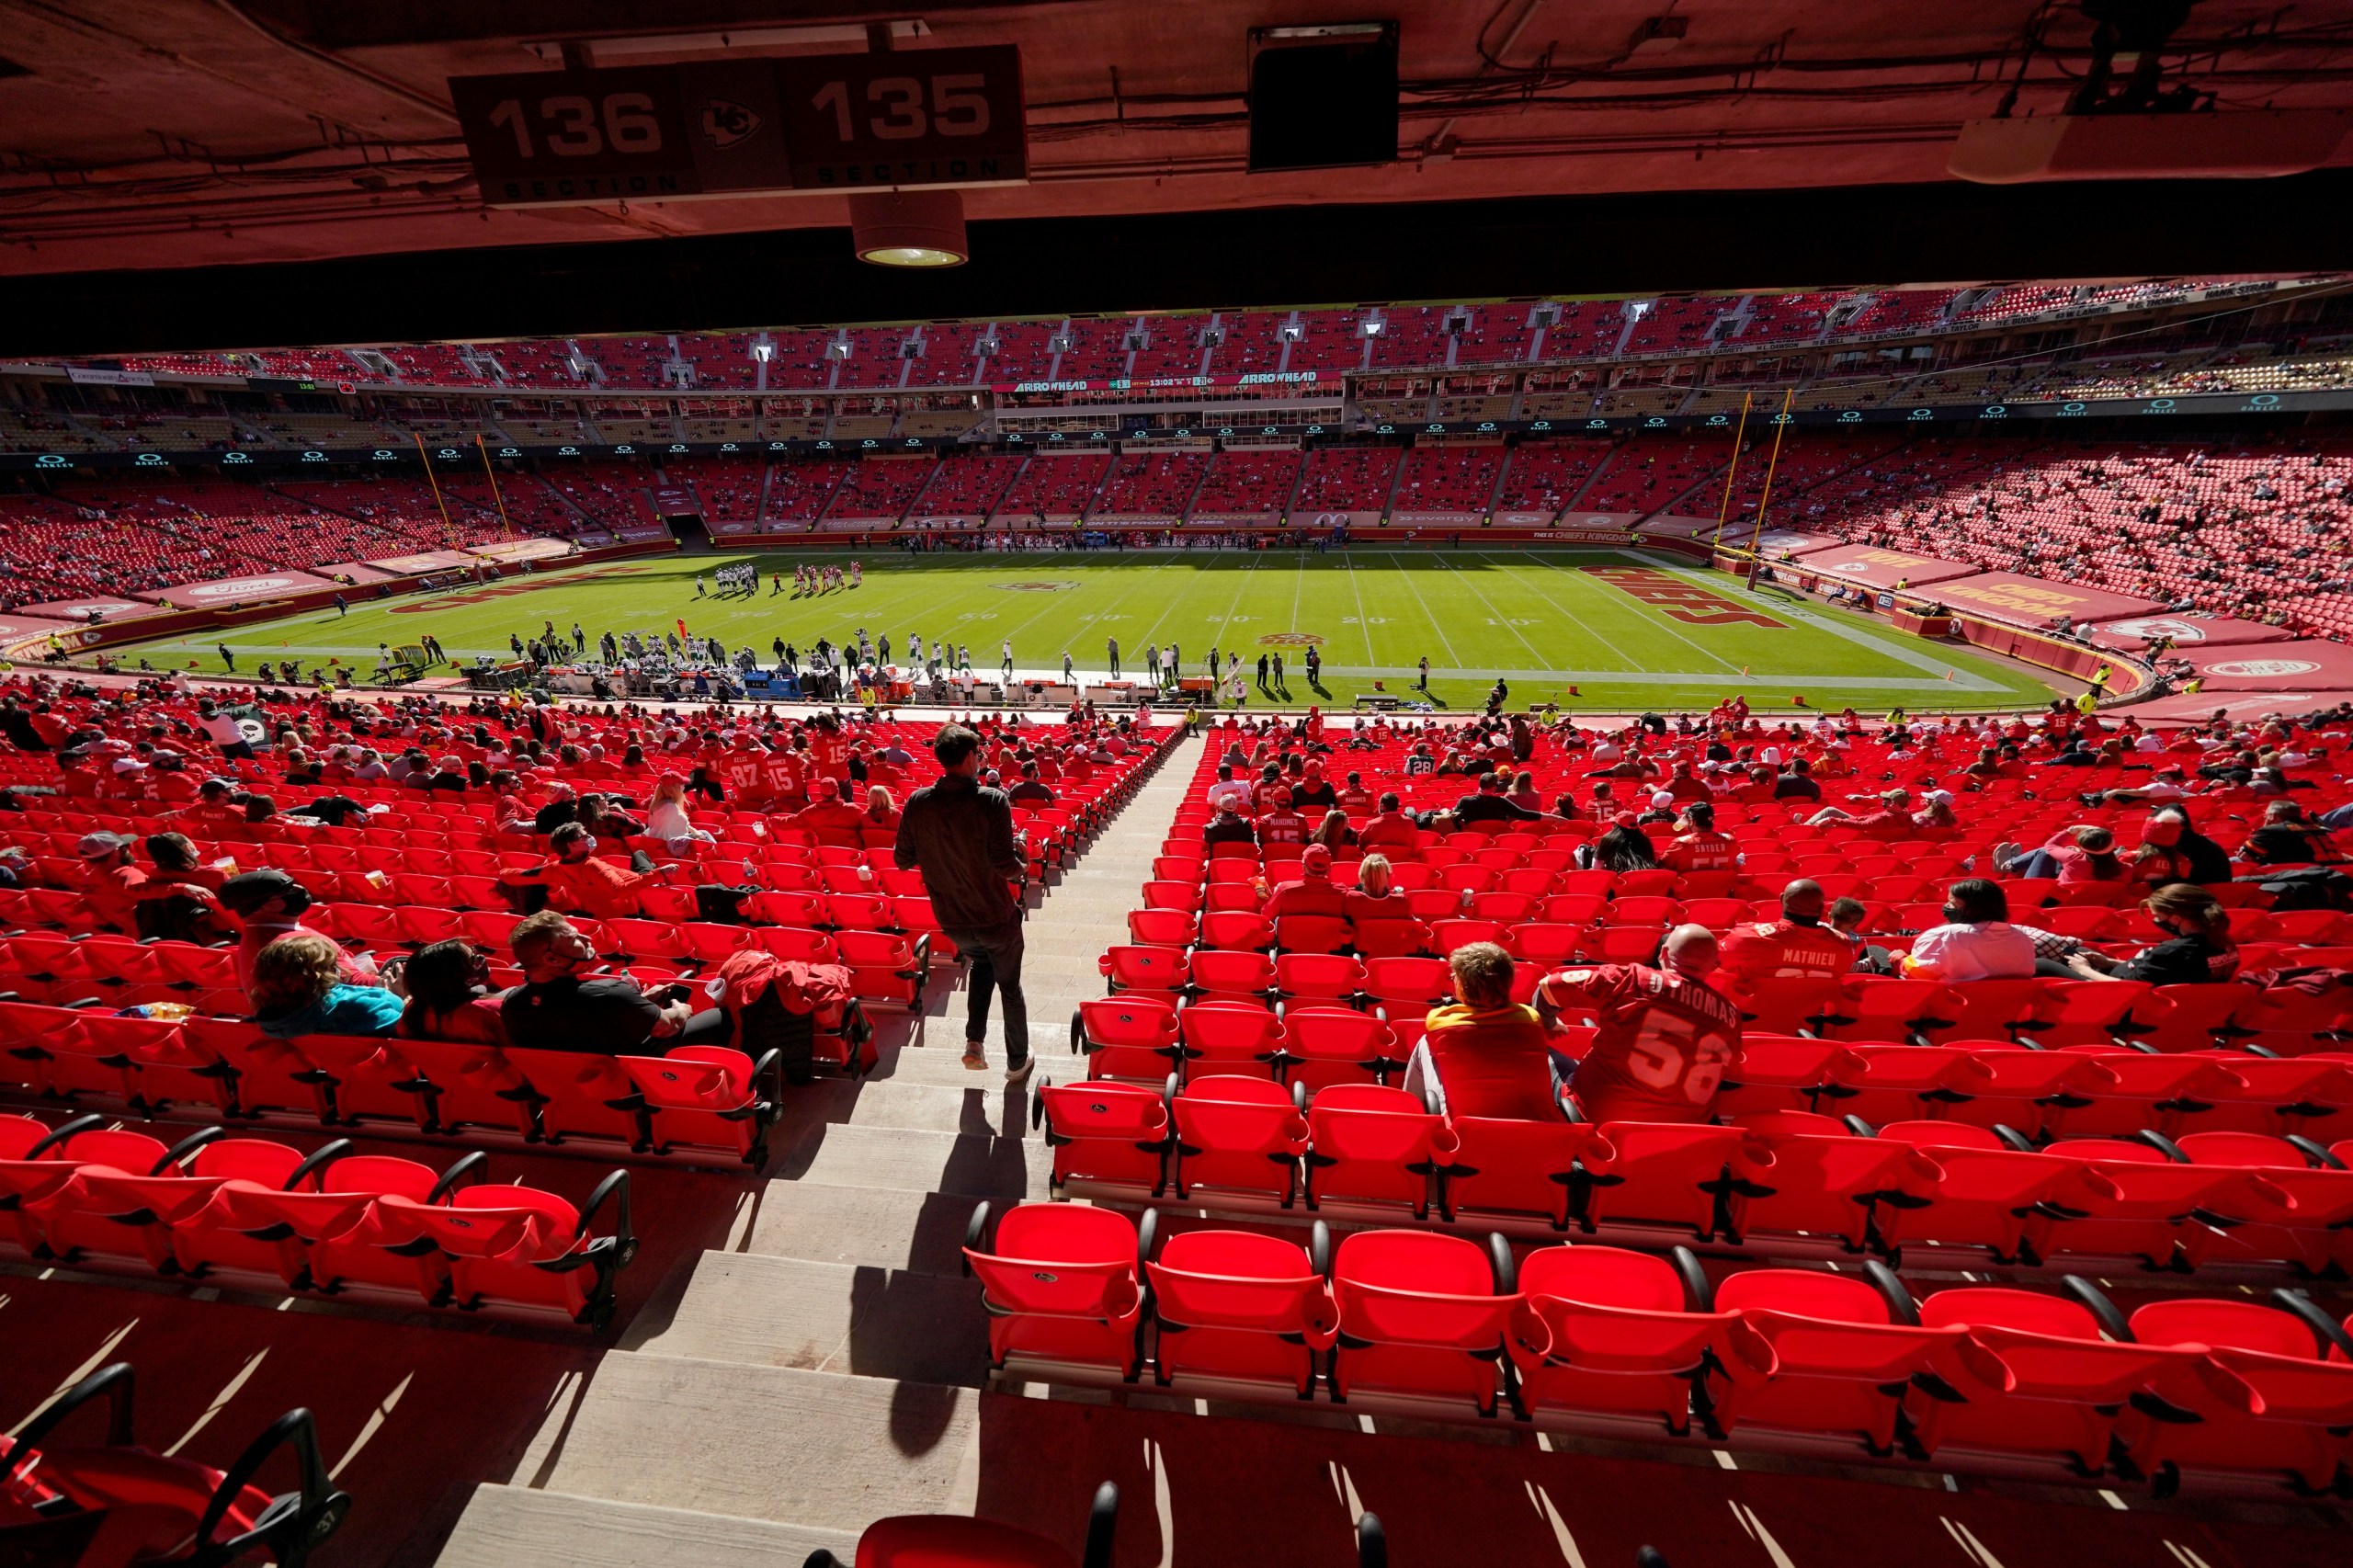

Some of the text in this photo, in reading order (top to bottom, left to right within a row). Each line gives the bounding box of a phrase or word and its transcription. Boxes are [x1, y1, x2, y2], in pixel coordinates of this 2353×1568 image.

[809, 71, 992, 142] 135
[487, 91, 663, 159] 136
[817, 156, 1000, 183] SECTION
[504, 173, 678, 199] SECTION
[2205, 281, 2278, 299] HANK STRAM
[2146, 295, 2188, 307] THOMAS
[2076, 306, 2109, 316] LANIER
[2012, 316, 2040, 325] BUDDE
[1876, 331, 1916, 339] BUCHANAN
[1238, 372, 1317, 384] ARROWHEAD
[1014, 381, 1087, 392] ARROWHEAD
[1854, 551, 1932, 568] VOTE
[215, 581, 274, 593] Ford
[1988, 583, 2091, 604] CHIEFS
[1577, 565, 1796, 628] CHIEFS
[1935, 585, 2074, 618] KINGDOM
[1342, 617, 1386, 625] 20
[1485, 618, 1535, 626] 10
[1713, 714, 1727, 724] 87
[2055, 718, 2066, 727] 15
[1378, 731, 1387, 740] 15
[829, 745, 845, 764] 15
[730, 763, 757, 788] 87
[1413, 762, 1433, 774] 28
[768, 767, 794, 791] 15
[1596, 808, 1614, 824] 15
[1271, 830, 1299, 843] 15
[1695, 844, 1726, 853] SNYDER
[2304, 836, 2343, 861] 15
[2156, 860, 2182, 869] KELE
[1783, 949, 1836, 966] MATHIEU
[1669, 979, 1737, 1029] THOMAS
[1627, 1008, 1732, 1104] 58
